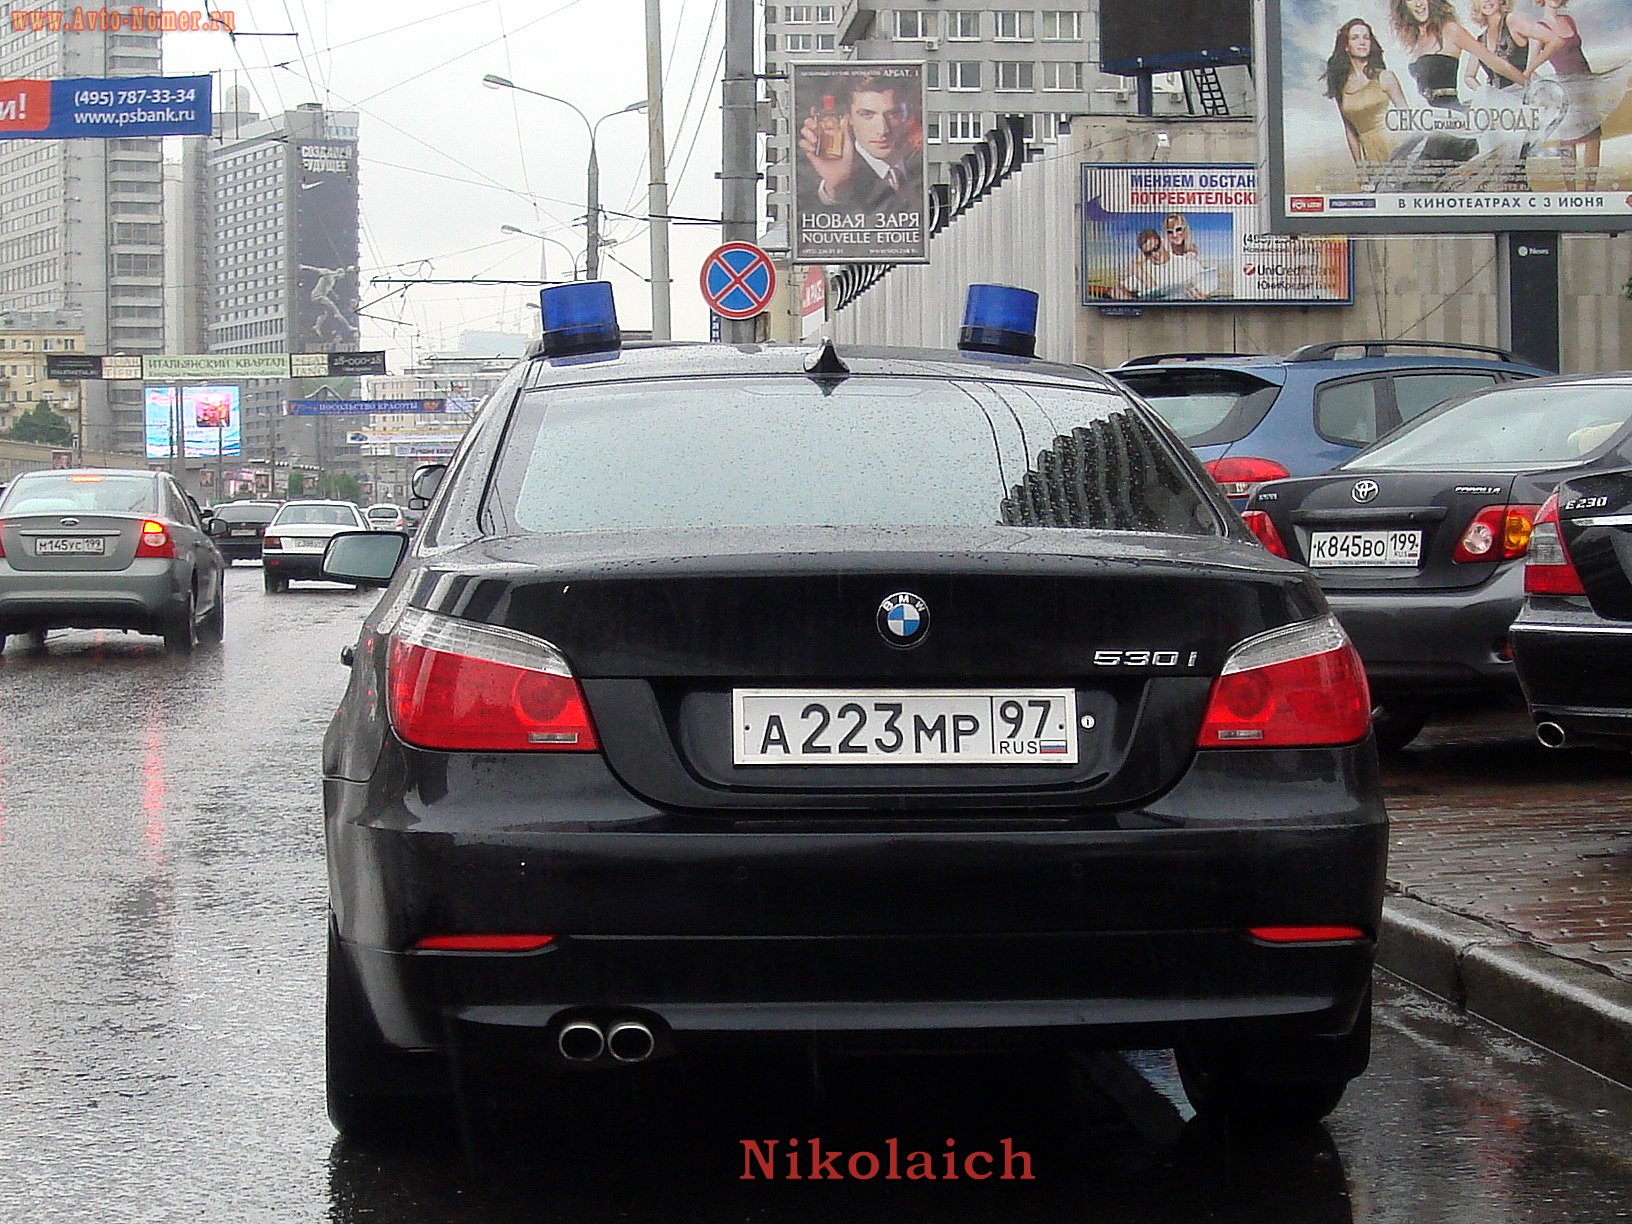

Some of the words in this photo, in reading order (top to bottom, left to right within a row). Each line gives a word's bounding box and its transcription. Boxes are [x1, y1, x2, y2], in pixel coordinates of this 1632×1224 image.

[74, 90, 114, 107] (495)
[118, 88, 196, 104] 787-33-34
[74, 108, 196, 127] www.psbank.ru
[1385, 109, 1434, 131] СЕКС
[1465, 108, 1540, 131] ГОРОДЕ
[1131, 175, 1194, 188] МЕНЯЕМ
[1399, 198, 1406, 208] В
[1414, 197, 1521, 208] КИНОТЕАТРАХ
[1529, 197, 1536, 207] С
[1544, 197, 1551, 207] 3
[1559, 197, 1604, 207] ИЮНЯ
[802, 213, 865, 228] НОВАЯ
[875, 212, 919, 228] ЗАРЯ
[802, 232, 871, 244] NOUVELLE
[877, 231, 919, 243] ETOILE
[149, 358, 231, 370] ИТАЛЬЯНСКИЙ
[235, 357, 285, 369] КВАРТАЛ
[1316, 535, 1386, 558] К845ВО
[1390, 533, 1417, 551] 199
[882, 595, 926, 612] BMW
[760, 703, 980, 754] А223МР
[999, 700, 1052, 739] 97
[1000, 741, 1038, 755] RUS
